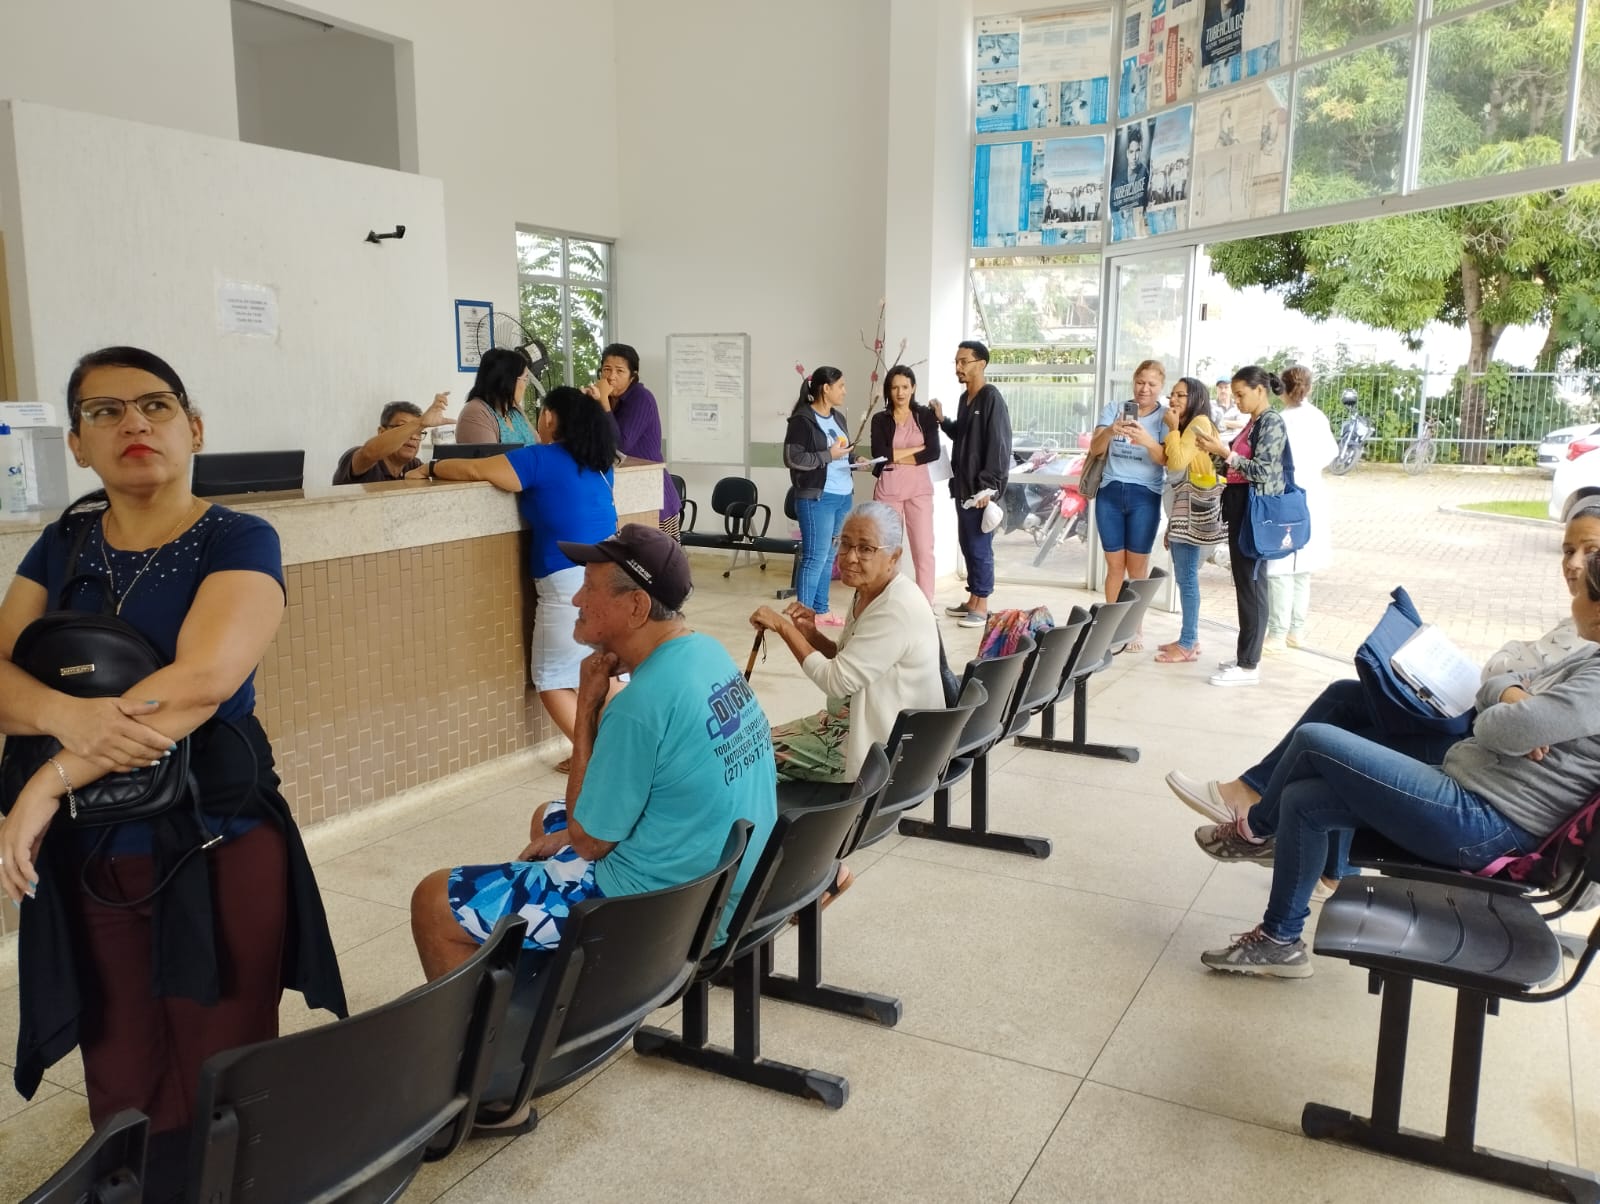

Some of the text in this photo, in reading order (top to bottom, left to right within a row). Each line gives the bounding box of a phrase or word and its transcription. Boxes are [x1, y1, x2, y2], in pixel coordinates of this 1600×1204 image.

[710, 674, 754, 726] DIGÃ
[713, 741, 731, 758] TODA
[724, 760, 743, 787] (27)
